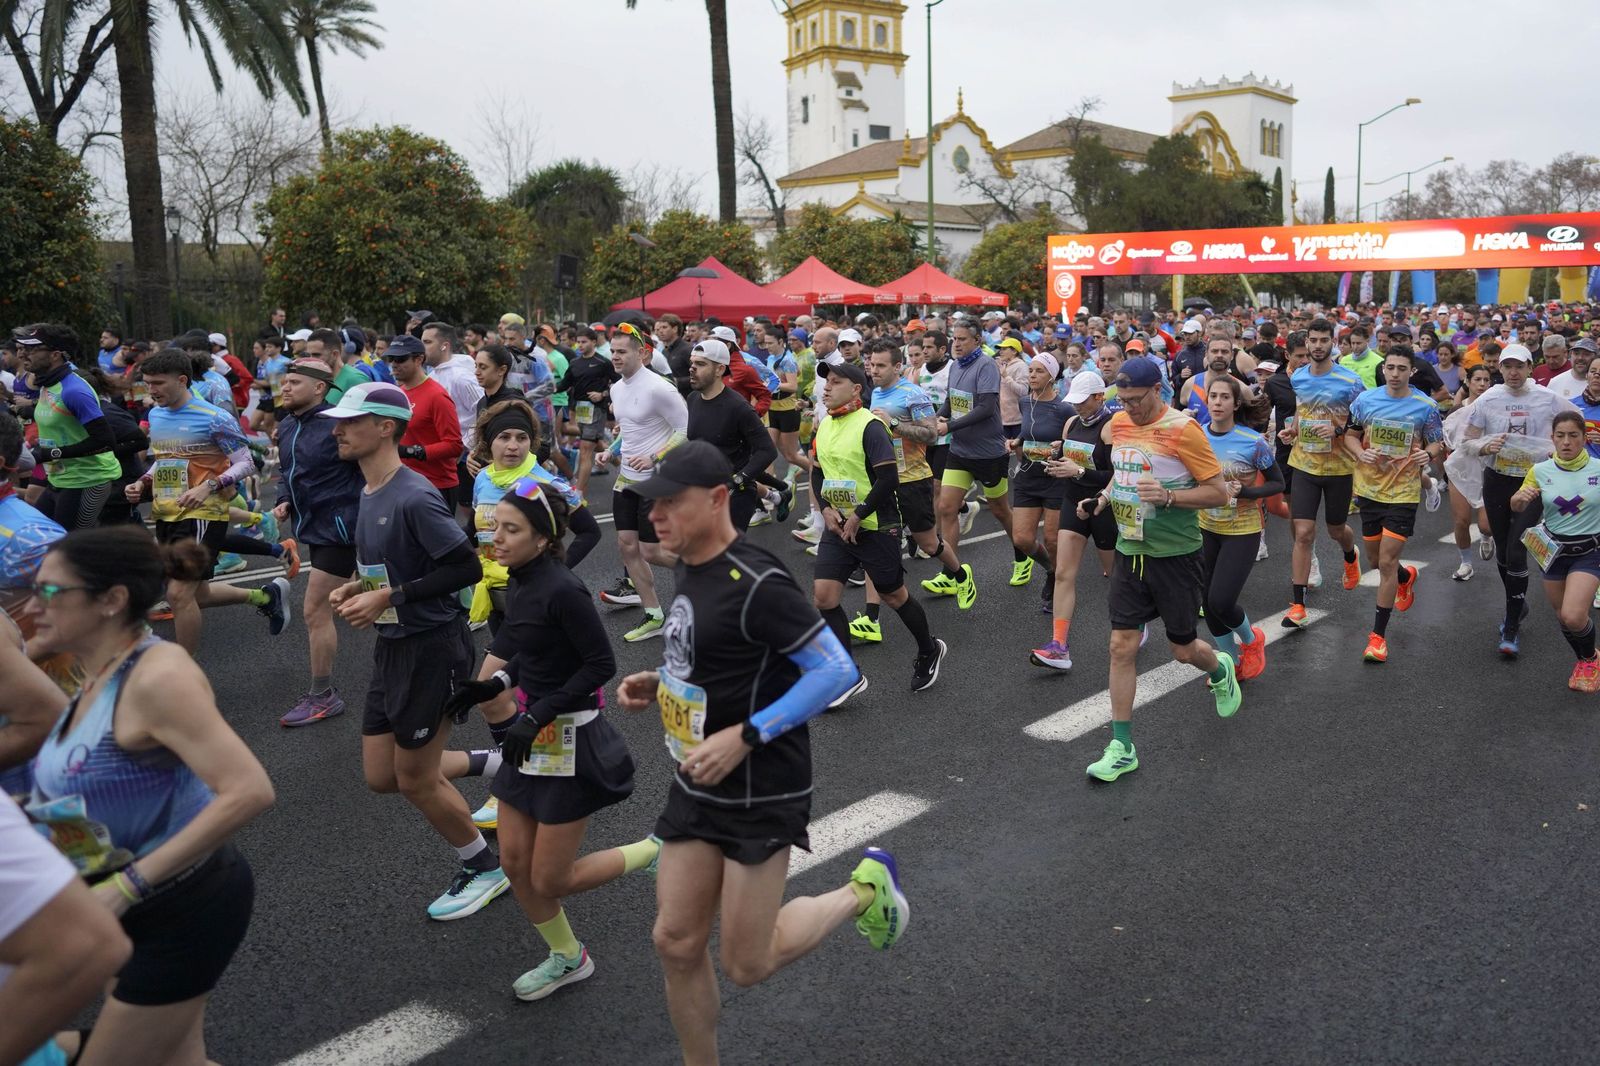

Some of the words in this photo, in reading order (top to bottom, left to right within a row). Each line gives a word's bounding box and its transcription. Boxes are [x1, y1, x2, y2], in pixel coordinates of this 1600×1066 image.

[1473, 232, 1530, 251] HOKA
[1540, 242, 1584, 252] HYUNDAI
[1202, 243, 1246, 260] HOKA
[1374, 427, 1406, 442] 12540
[156, 469, 178, 482] 9319
